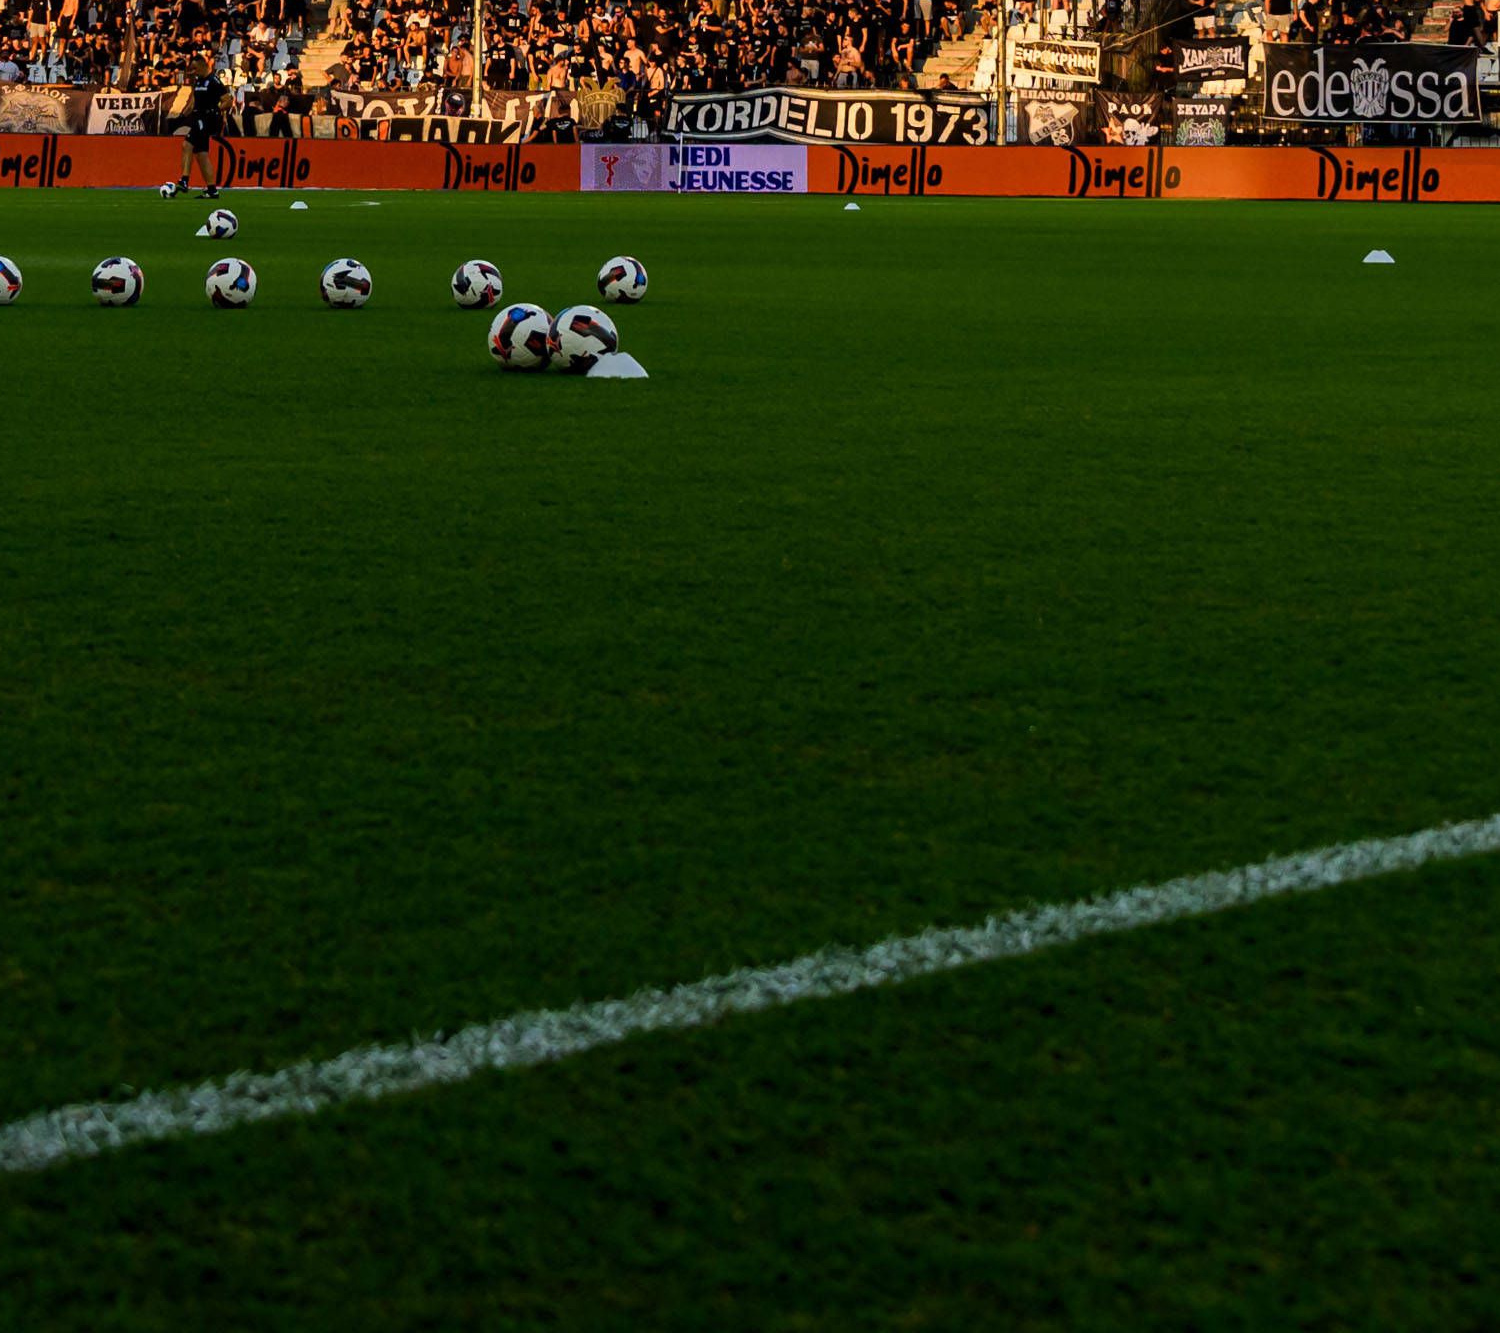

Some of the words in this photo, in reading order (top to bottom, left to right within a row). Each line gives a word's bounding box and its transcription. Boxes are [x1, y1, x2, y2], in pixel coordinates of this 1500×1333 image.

[95, 94, 154, 110] VERIA
[1271, 47, 1475, 120] edessa
[666, 93, 874, 141] KORDELIO
[889, 101, 989, 146] 1973
[1176, 103, 1227, 116] ΣΚΥΔΡΑ
[209, 136, 310, 189] Dimello
[438, 142, 537, 191] Dimello
[668, 146, 730, 167] MEDI
[668, 170, 794, 191] JEUNESSE
[835, 144, 943, 195] Dimello
[1061, 145, 1182, 198] Dimello
[1308, 145, 1440, 202] Dimello
